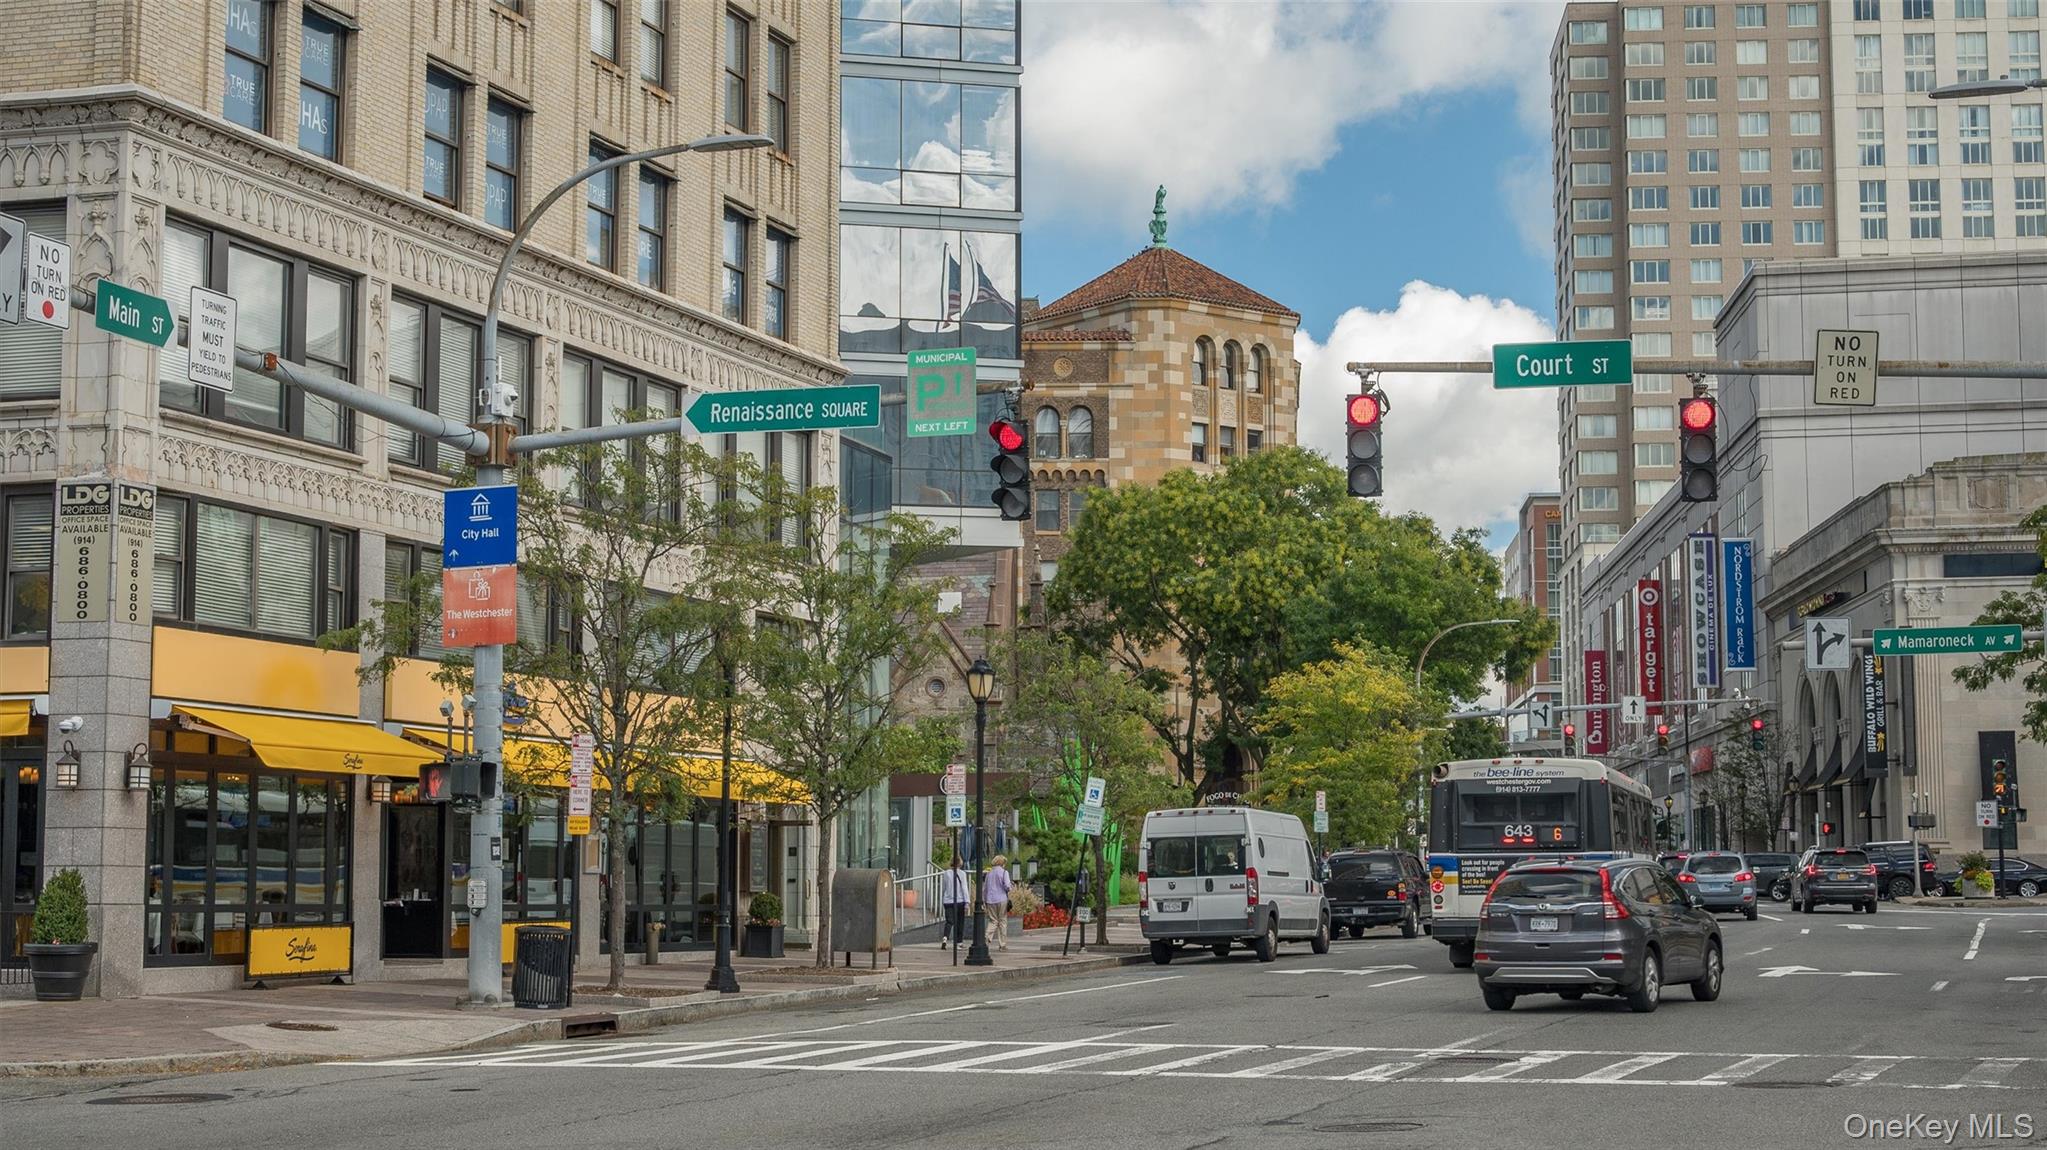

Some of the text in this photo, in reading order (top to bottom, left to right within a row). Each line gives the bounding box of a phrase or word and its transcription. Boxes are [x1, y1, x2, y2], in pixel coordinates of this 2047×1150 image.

[304, 36, 329, 56] TRUE
[230, 74, 256, 94] TRUE
[229, 86, 255, 106] CARE
[487, 123, 507, 144] TRUE
[425, 156, 445, 174] TRUE
[40, 244, 60, 264] NO
[36, 264, 62, 282] TURN
[31, 280, 66, 301] ON RED
[109, 295, 164, 335] Main ST
[202, 298, 228, 315] TURNING
[201, 314, 226, 331] TRAFFIC
[202, 329, 224, 348] MUST
[1834, 336, 1861, 352] NO
[199, 347, 226, 365] YIELD TO
[915, 352, 968, 364] MUNICIPAL
[1827, 354, 1868, 368] TURN
[191, 362, 232, 382] PEDESTRIANS
[1516, 353, 1609, 377] Court ST
[1836, 370, 1857, 384] ON
[1830, 386, 1860, 400] RED
[710, 400, 868, 424] Renaissance SQUARE
[915, 421, 969, 433] NEXT LEFT
[62, 485, 110, 505] LDG
[120, 486, 153, 510] LDG
[61, 504, 110, 515] PROPERTIES
[120, 505, 153, 520] PROPERTIES
[61, 515, 109, 523] OFFICE SPACE
[61, 523, 109, 534] AVAILABLE
[120, 525, 152, 539] AVAILABLE
[461, 527, 500, 541] City Hall
[73, 535, 96, 545] (914)
[127, 537, 143, 548] (914)
[1734, 546, 1745, 624] NORDSTROM
[1708, 597, 1714, 609] DE
[447, 607, 513, 620] The Westchester
[1694, 540, 1708, 686] SHOWCASE
[1897, 633, 1996, 649] Mamaroneck AV
[1644, 612, 1657, 692] target
[1875, 680, 1884, 697] BAR
[1864, 654, 1877, 753] BUFFALO WILD WINGS
[1876, 706, 1884, 727] GRILL
[1486, 778, 1551, 786] westchestergov.com
[1487, 767, 1534, 778] bee-line
[1535, 770, 1565, 780] system
[1206, 791, 1224, 802] FOGO
[1495, 785, 1541, 793] (914) 813-7777
[1504, 824, 1533, 837] 643
[1553, 827, 1562, 841] 6
